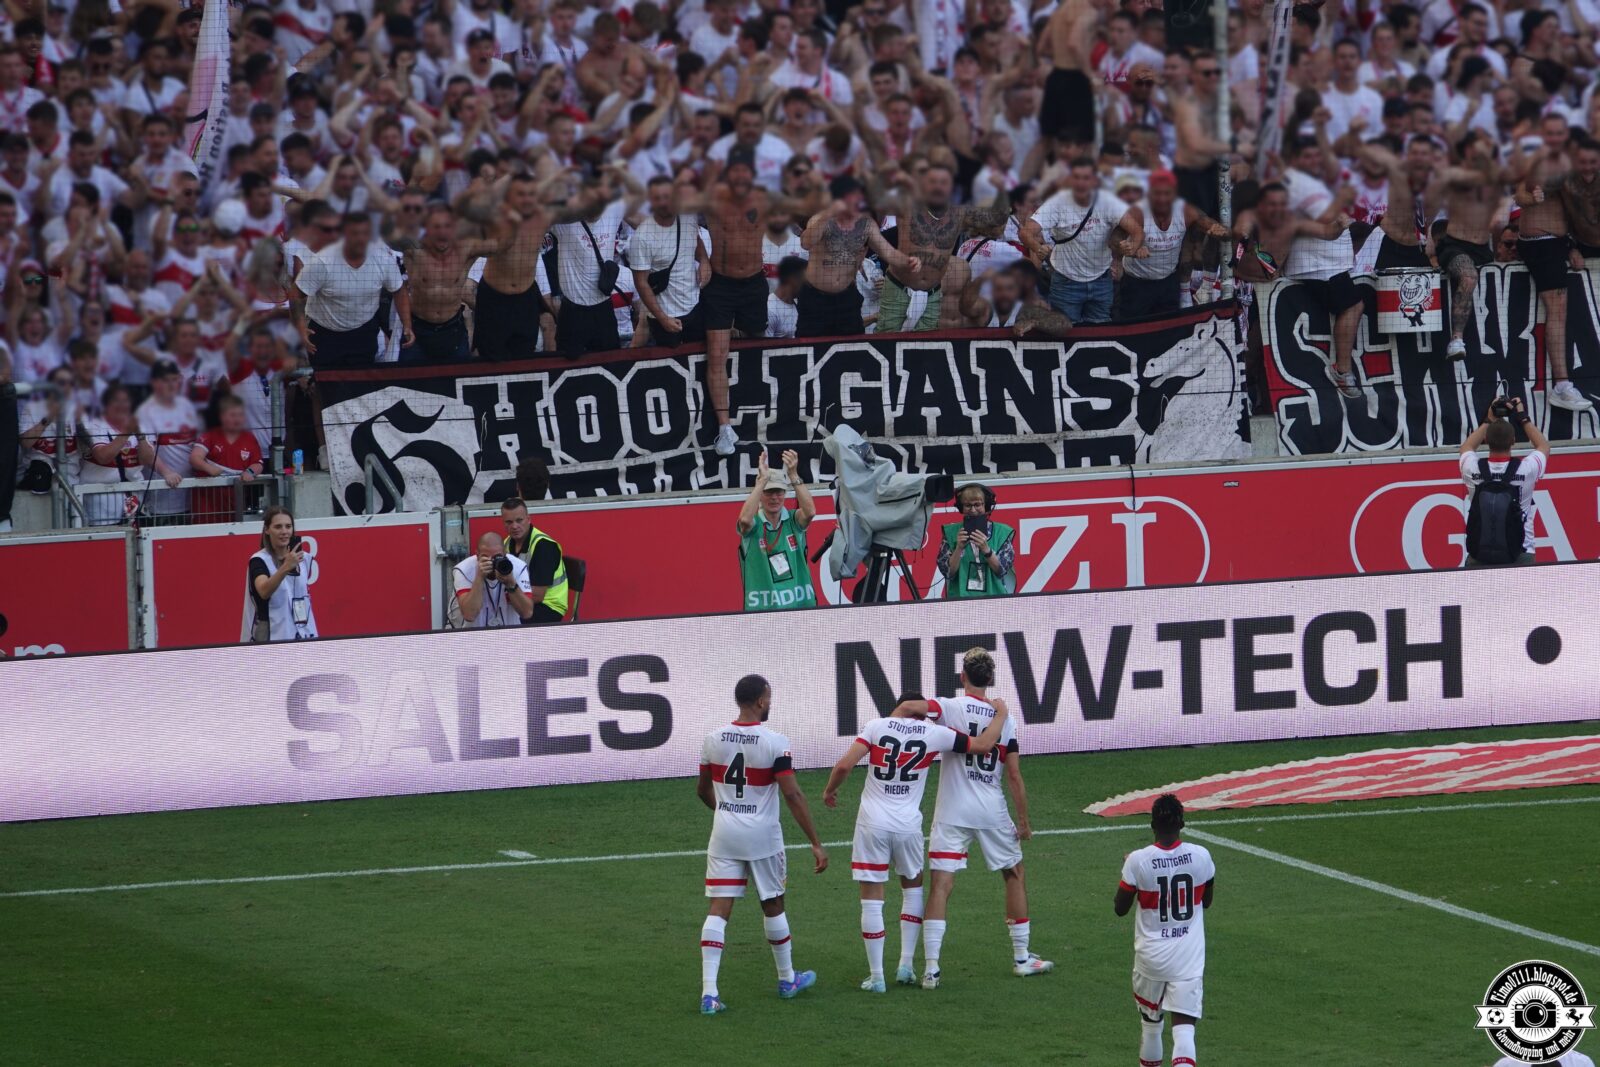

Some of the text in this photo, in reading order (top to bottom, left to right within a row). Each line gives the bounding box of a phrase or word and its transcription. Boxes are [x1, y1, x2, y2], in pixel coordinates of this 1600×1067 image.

[456, 340, 1139, 474] HOOLIGANS
[834, 604, 1464, 737] NEW-TECH
[286, 653, 674, 771] SALES
[887, 720, 927, 735] STUTTGART
[720, 732, 760, 745] STUTTGART
[873, 735, 927, 782] 32
[723, 752, 748, 799] 4
[884, 784, 910, 795] RIEDER
[1151, 853, 1193, 870] STUTTGART
[1156, 873, 1195, 923] 10
